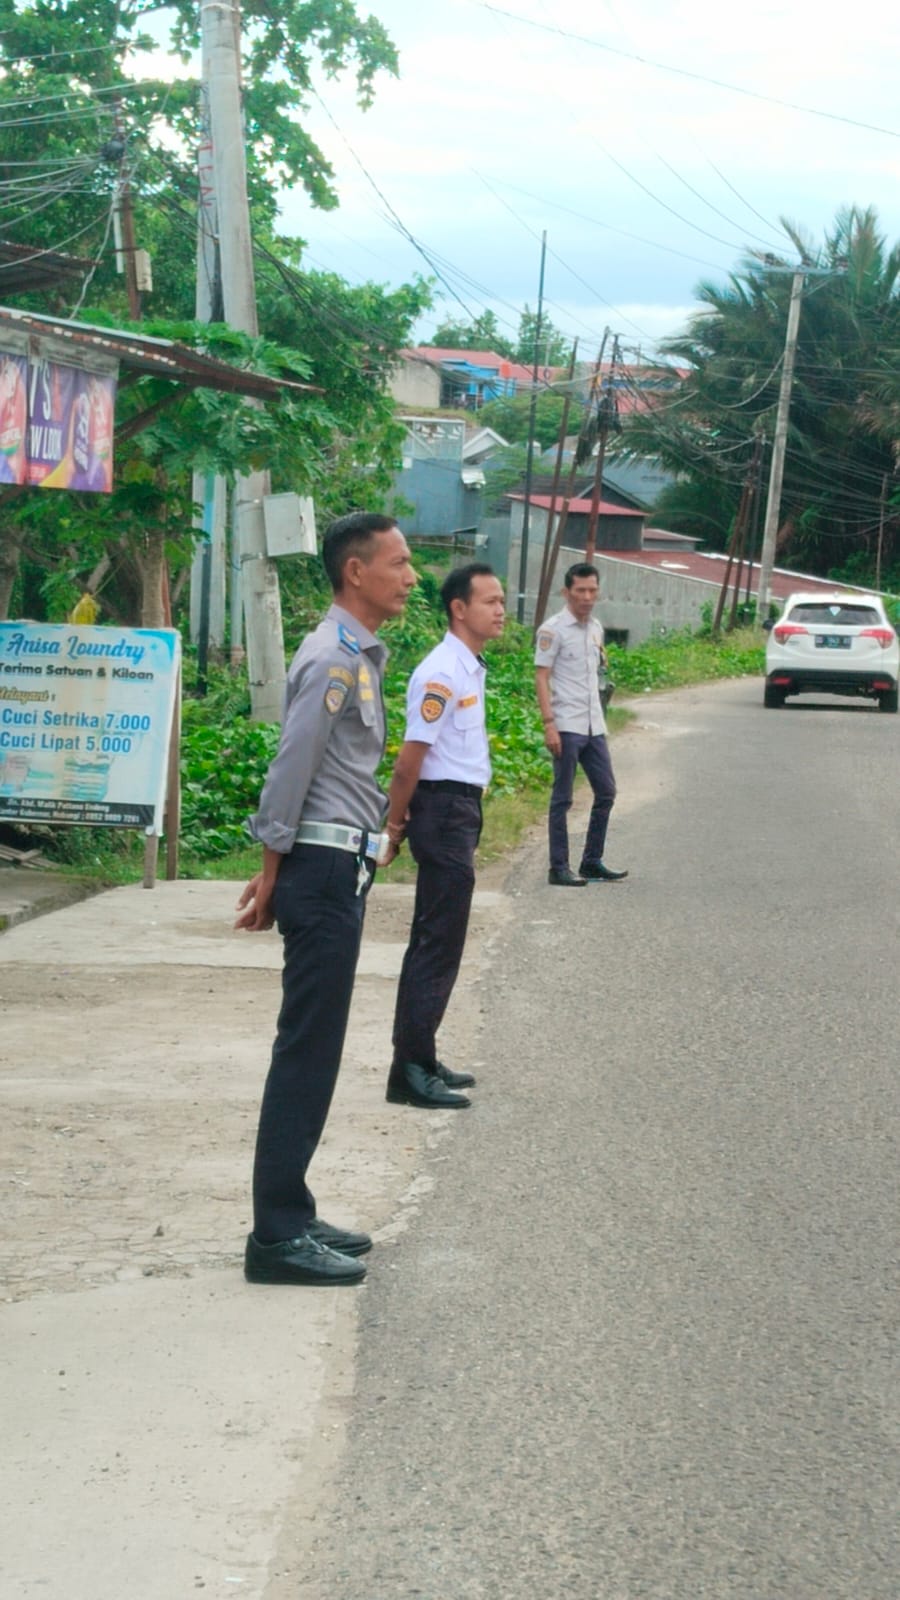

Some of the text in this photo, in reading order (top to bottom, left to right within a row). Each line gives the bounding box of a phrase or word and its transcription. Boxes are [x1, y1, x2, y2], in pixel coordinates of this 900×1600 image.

[6, 633, 61, 656] Anisa
[0, 662, 154, 681] Terima Satuan & Kiloan
[2, 708, 151, 731] Cuci Setrika 7.000
[0, 731, 132, 753] Cuci Lipat 5.000
